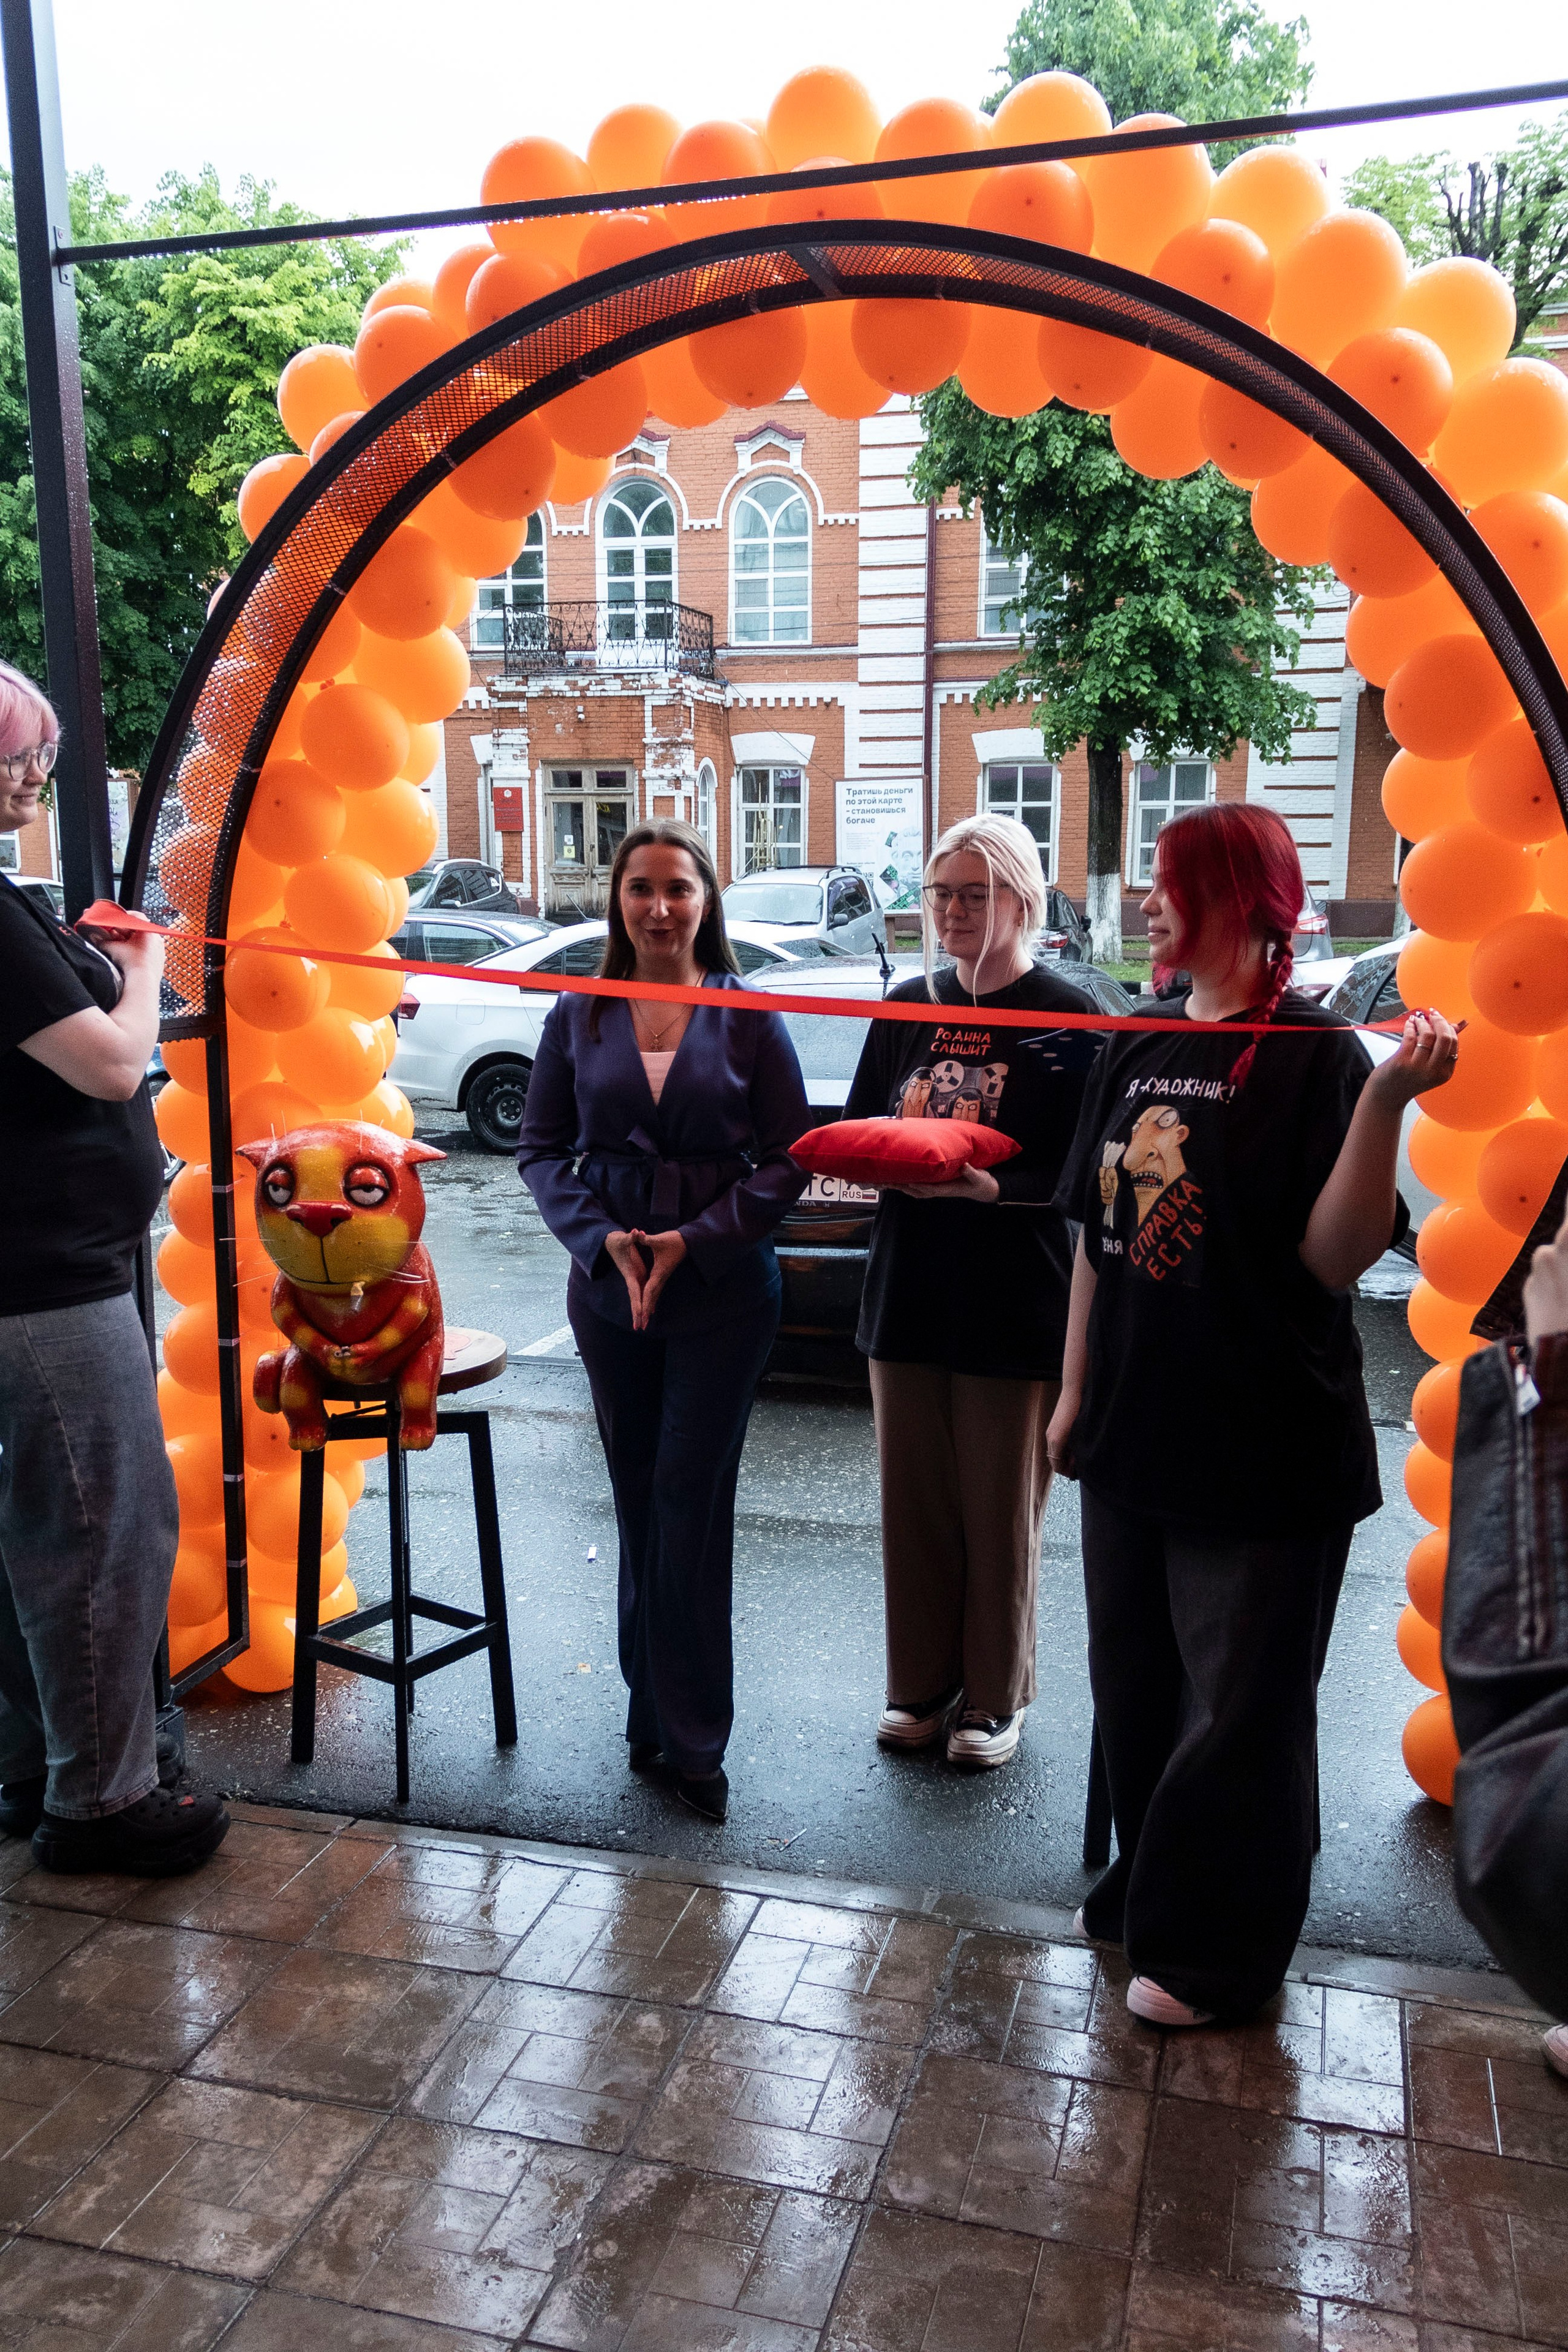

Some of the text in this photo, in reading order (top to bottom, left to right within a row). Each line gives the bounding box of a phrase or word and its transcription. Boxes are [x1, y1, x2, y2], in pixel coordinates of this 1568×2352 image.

[846, 788, 882, 797] Тратишь
[935, 1028, 991, 1043] РОДИНА
[930, 1042, 991, 1055] СЛЫШИТ
[1129, 1180, 1202, 1266] СПРАВКА
[1147, 1204, 1207, 1281] ЕСТЬ!
